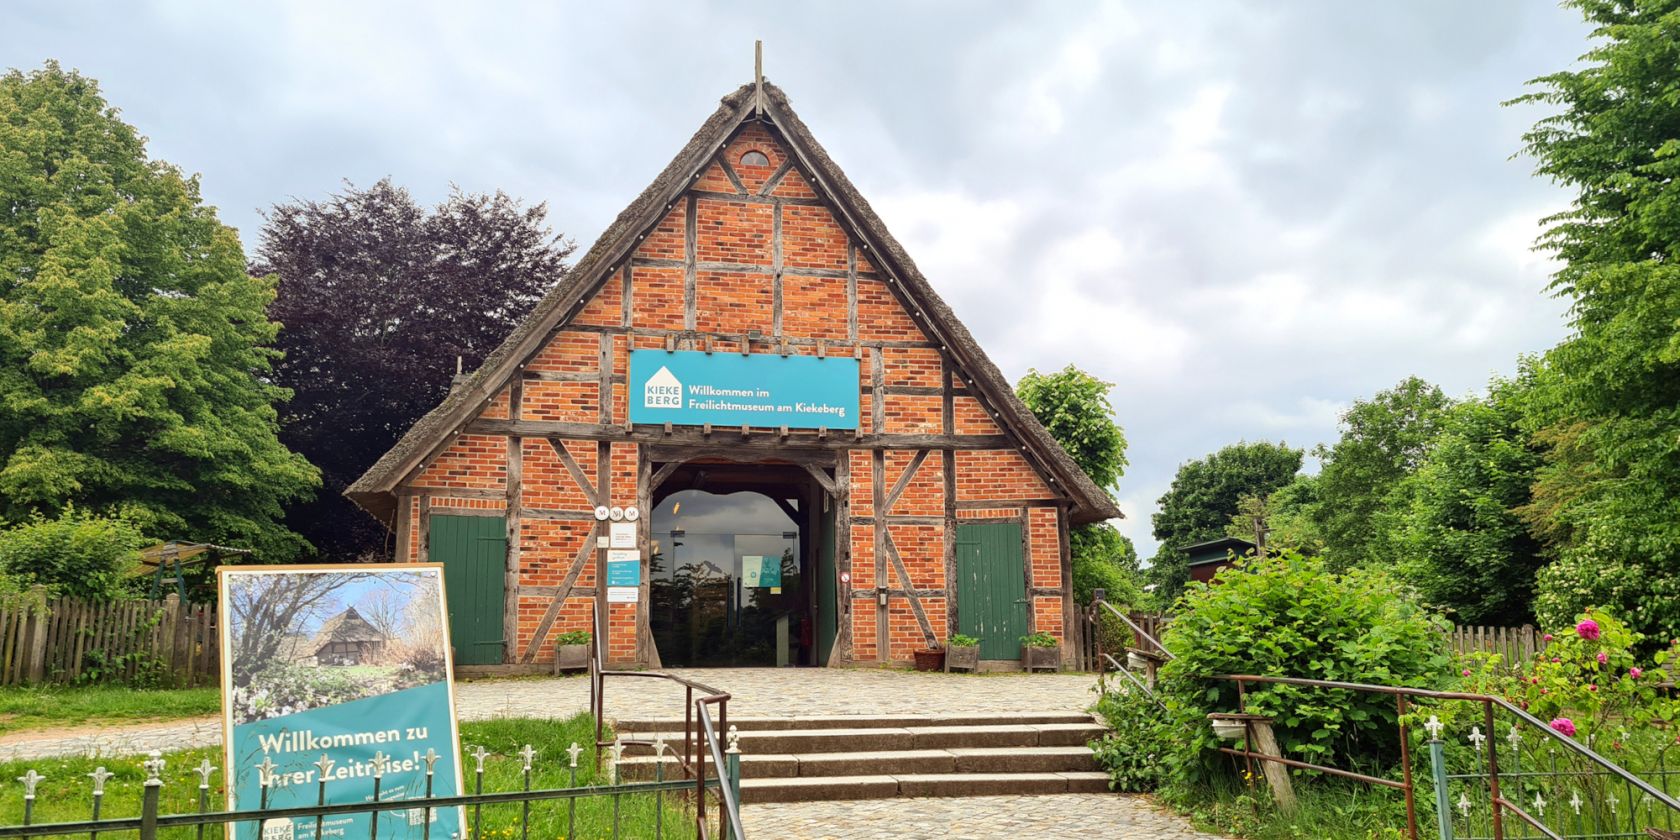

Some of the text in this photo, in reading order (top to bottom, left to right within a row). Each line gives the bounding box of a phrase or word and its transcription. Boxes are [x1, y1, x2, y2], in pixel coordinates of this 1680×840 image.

[647, 385, 680, 395] KIEKE
[689, 385, 770, 398] Willkommen im
[647, 396, 680, 406] BERG
[689, 399, 846, 418] Freilichtmuseum am Kiekeberg
[258, 726, 428, 754] Willkommen zu
